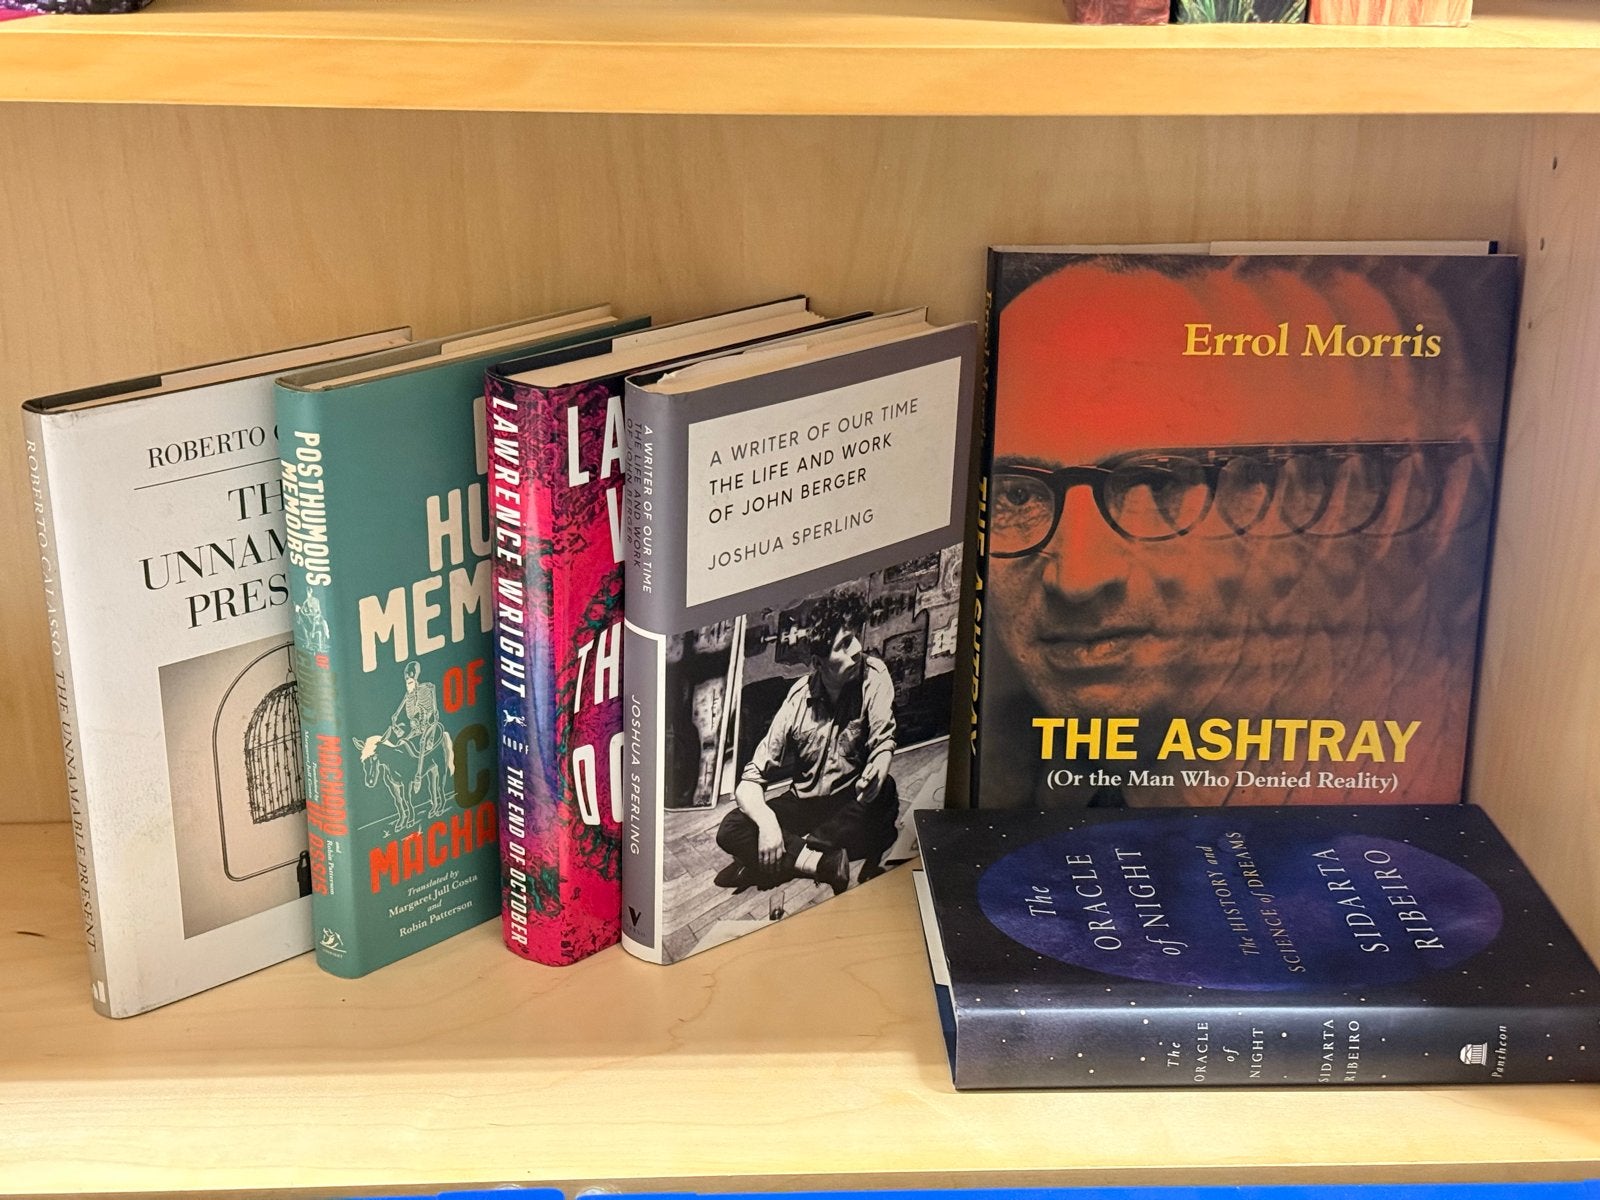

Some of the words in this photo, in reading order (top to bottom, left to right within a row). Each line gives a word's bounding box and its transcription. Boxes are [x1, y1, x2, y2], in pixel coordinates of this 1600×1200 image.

[1182, 322, 1289, 356] Errol
[1301, 324, 1441, 358] Morris
[148, 426, 265, 469] ROBERTO
[634, 423, 642, 450] THE
[644, 425, 653, 434] A
[709, 450, 722, 467] A
[731, 430, 799, 461] WRITER
[807, 422, 831, 441] OF
[837, 411, 874, 433] OUR
[881, 398, 919, 421] TIME
[492, 396, 523, 567] LAWRENCE
[643, 443, 653, 495] WRITER
[709, 473, 745, 496] THE
[752, 461, 789, 485] LIFE
[796, 450, 834, 473] AND
[842, 432, 893, 460] WORK
[281, 460, 304, 567] MEMOIRS
[294, 431, 331, 587] POSTHUMOUS
[633, 489, 641, 520] AND
[643, 501, 652, 520] OF
[708, 504, 734, 524] OF
[742, 488, 793, 515] JOHN
[800, 468, 867, 499] BERGER
[633, 526, 641, 567] WORK
[643, 526, 652, 555] OUR
[707, 537, 784, 571] JOSHUA
[792, 508, 874, 545] SPERLING
[185, 573, 289, 629] PRES
[642, 562, 652, 593] TIME
[315, 655, 330, 670] OF
[498, 576, 526, 698] WRIGHT
[26, 440, 47, 549] ROBERTO
[41, 556, 62, 656] CALASSO
[55, 671, 69, 714] THE
[62, 721, 84, 856] UNNAMABLE
[77, 862, 97, 952] PRESENT
[442, 658, 485, 714] OF
[502, 734, 529, 755] KNOPF
[630, 695, 641, 766] JOSHUA
[1031, 718, 1139, 760] THE
[1156, 718, 1422, 762] ASHTRAY
[316, 734, 347, 837] MACHADO
[507, 766, 524, 801] THE
[1046, 769, 1083, 790] (Or
[1089, 769, 1122, 787] the
[1127, 771, 1175, 787] Man
[1180, 771, 1230, 788] Who
[1235, 770, 1311, 789] Denied
[1317, 771, 1399, 793] Reality)
[507, 801, 526, 832] END
[630, 772, 641, 855] SPERLING
[309, 831, 328, 896] ASSIS
[507, 838, 526, 866] OF
[1195, 845, 1218, 865] and
[1225, 832, 1264, 887] DREAMS
[388, 893, 432, 918] Margaret
[432, 884, 450, 901] Jull
[451, 874, 478, 890] Costa
[407, 873, 448, 896] Translated
[449, 870, 459, 879] by
[427, 898, 442, 912] and
[508, 868, 528, 946] OCTOBER
[1025, 886, 1056, 916] The
[1066, 854, 1122, 950] ORACLE
[1114, 848, 1170, 928] NIGHT
[1206, 870, 1249, 931] HISTORY
[1250, 890, 1276, 903] of
[1311, 848, 1390, 952] SIDARTA
[1364, 850, 1445, 949] RIBEIRO
[399, 920, 428, 938] Robin
[429, 900, 473, 924] Patterson
[1260, 909, 1306, 973] SCIENCE
[1145, 935, 1190, 957] of
[1239, 936, 1260, 955] The
[1167, 1041, 1181, 1068] The
[1194, 1021, 1209, 1083] ORACLE
[1222, 1046, 1240, 1063] of
[1249, 1027, 1265, 1079] NIGHT
[1318, 1018, 1335, 1084] SIDARTA
[1343, 1020, 1360, 1083] RIBEIRO
[1491, 1024, 1508, 1079] Pantheon
